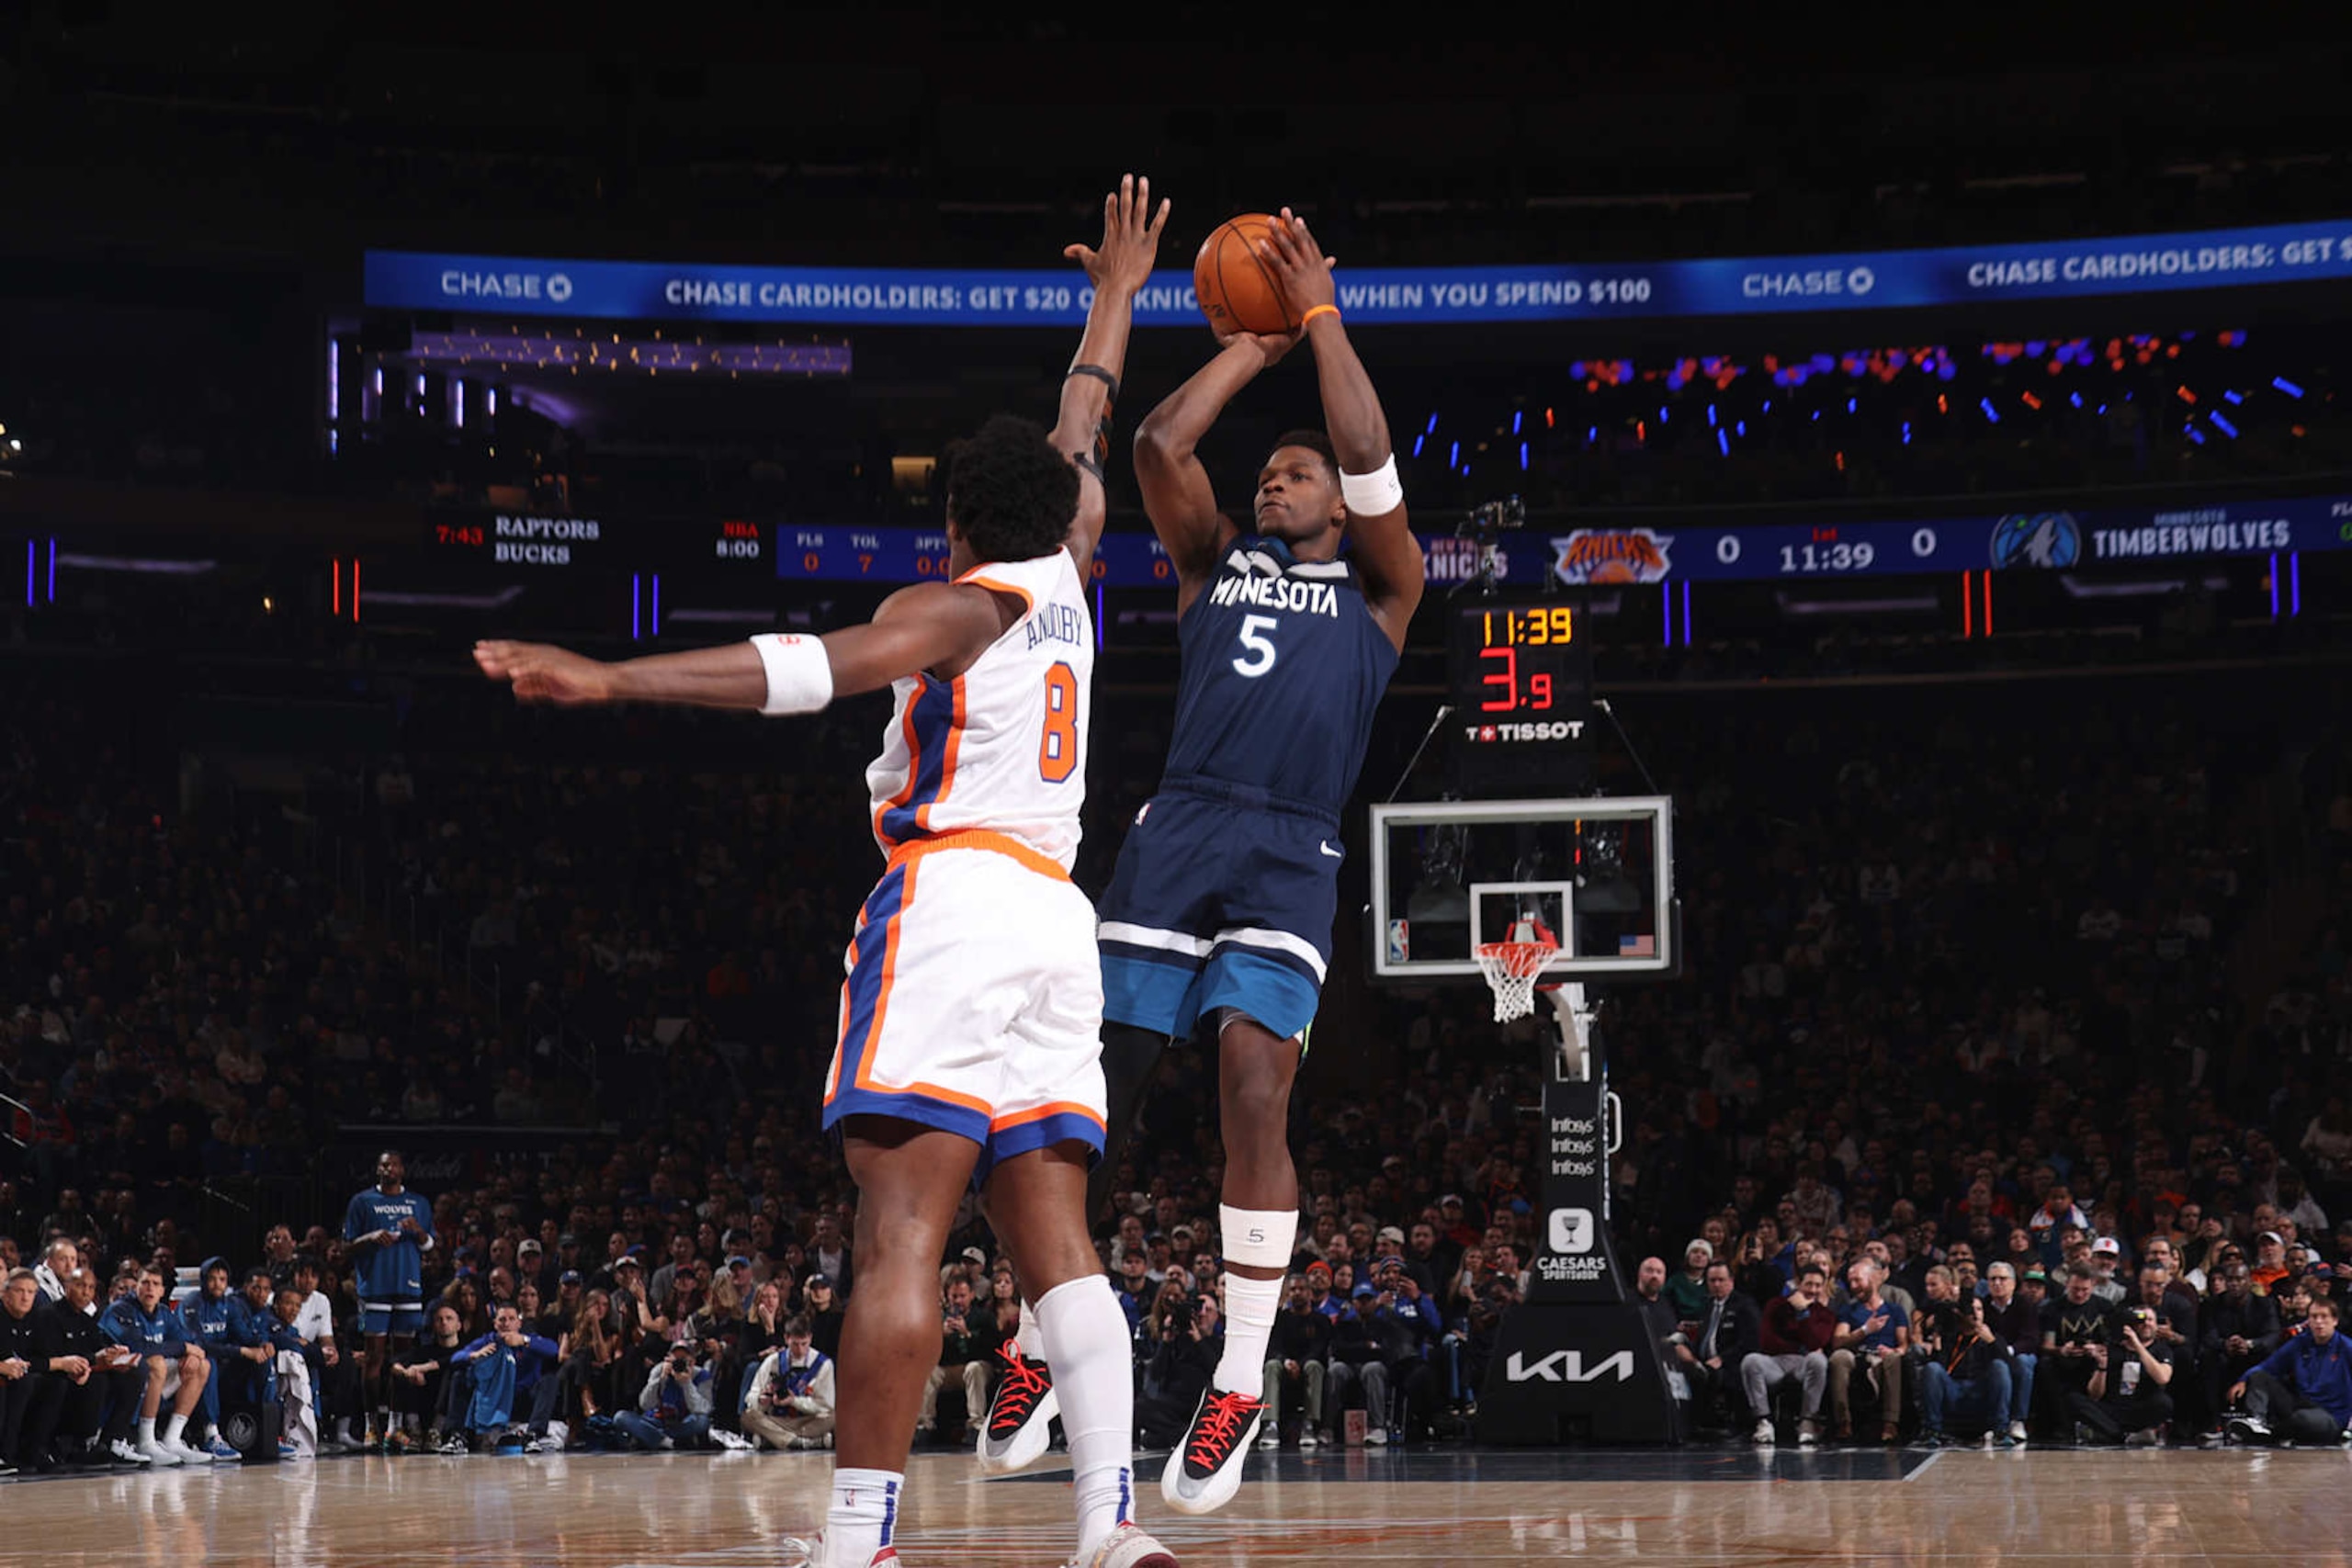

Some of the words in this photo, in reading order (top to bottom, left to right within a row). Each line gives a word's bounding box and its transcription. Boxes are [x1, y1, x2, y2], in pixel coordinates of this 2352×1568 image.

[1968, 258, 2056, 288] CHASE
[2063, 243, 2275, 281] CARDHOLDERS:
[2281, 238, 2335, 265] GET
[442, 271, 541, 299] CHASE
[665, 279, 752, 306] CHASE
[760, 284, 962, 310] CARDHOLDERS:
[969, 286, 1017, 310] GET
[1024, 286, 1070, 310] $20
[1135, 287, 1198, 310] KNIC
[1340, 285, 1423, 309] WHEN
[1430, 283, 1487, 306] YOU
[1495, 281, 1581, 306] SPEND
[1589, 278, 1651, 304] $100
[1743, 270, 1842, 298] CHASE
[435, 525, 484, 545] 7:43
[495, 515, 600, 540] RAPTORS
[723, 522, 760, 538] NBA
[2093, 519, 2291, 558] TIMBERWOLVES
[495, 542, 571, 565] BUCKS
[1563, 535, 1664, 571] KNICKS
[1716, 535, 1740, 564] 0
[1912, 527, 1937, 558] 0
[804, 553, 819, 572] 0
[859, 554, 874, 574] 7
[1780, 543, 1874, 571] 11:39
[1484, 607, 1572, 647] 11:39
[1232, 613, 1278, 678] 5
[1479, 647, 1553, 712] 3.9
[1039, 660, 1078, 784] 8
[1498, 721, 1584, 741] TISSOT
[1551, 1117, 1595, 1135] Infosys
[1551, 1138, 1595, 1156] Infosys
[1551, 1159, 1595, 1178] Infosys
[1246, 1227, 1265, 1244] 5
[1537, 1257, 1606, 1270] CAESARS
[1507, 1349, 1634, 1382] KIA
